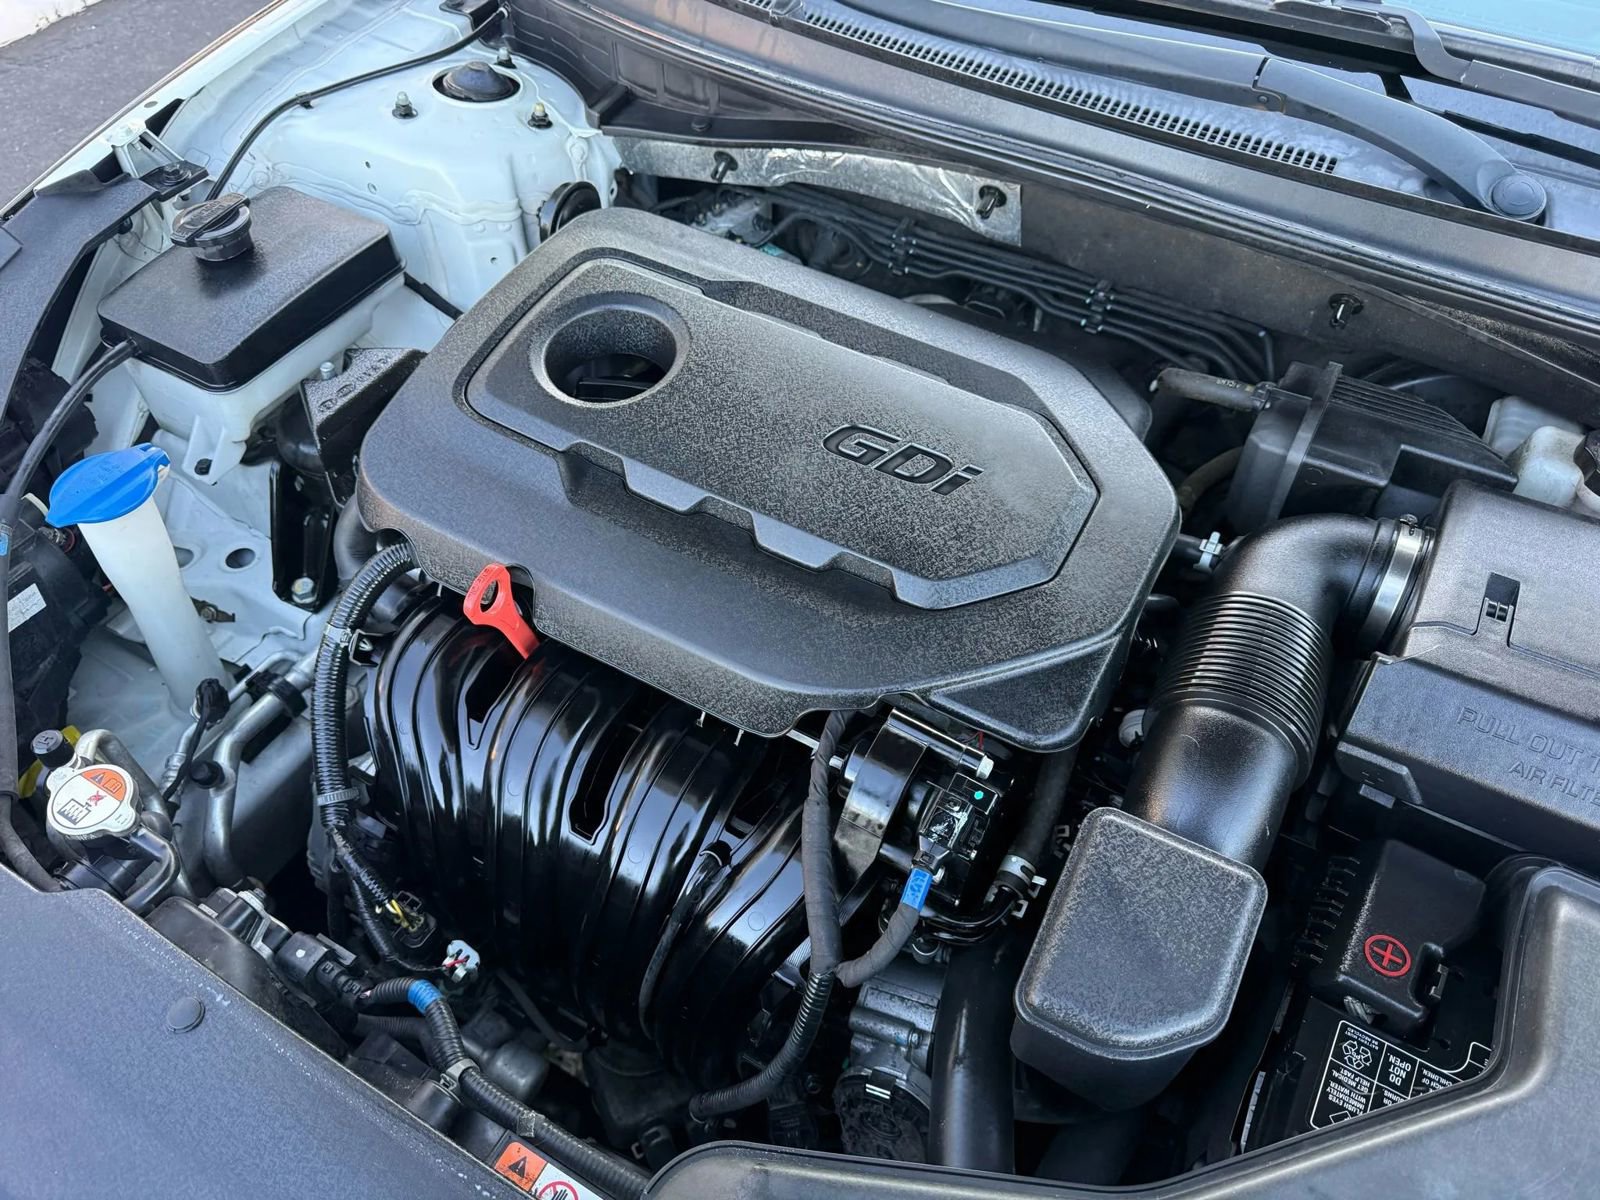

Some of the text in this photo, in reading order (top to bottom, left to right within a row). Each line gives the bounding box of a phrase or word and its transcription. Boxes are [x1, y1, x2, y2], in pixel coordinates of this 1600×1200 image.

[821, 423, 985, 496] GDi
[1457, 706, 1519, 746] PULL
[1528, 733, 1584, 765] OUT
[1508, 760, 1547, 785] AIR
[1344, 1030, 1379, 1051] BATTERY MUST
[1347, 1027, 1372, 1042] RECYCLED
[1387, 1053, 1411, 1072] OPEN.
[1388, 1064, 1407, 1079] NOT
[1331, 1069, 1369, 1094] GET MEDICAL
[1340, 1067, 1370, 1088] HELP FAST.
[1389, 1073, 1402, 1086] DO
[1421, 1077, 1430, 1085] OF
[1326, 1086, 1365, 1110] IMMEDIATELY
[1328, 1094, 1343, 1106] EYES
[1329, 1079, 1366, 1104] WITH WATER.
